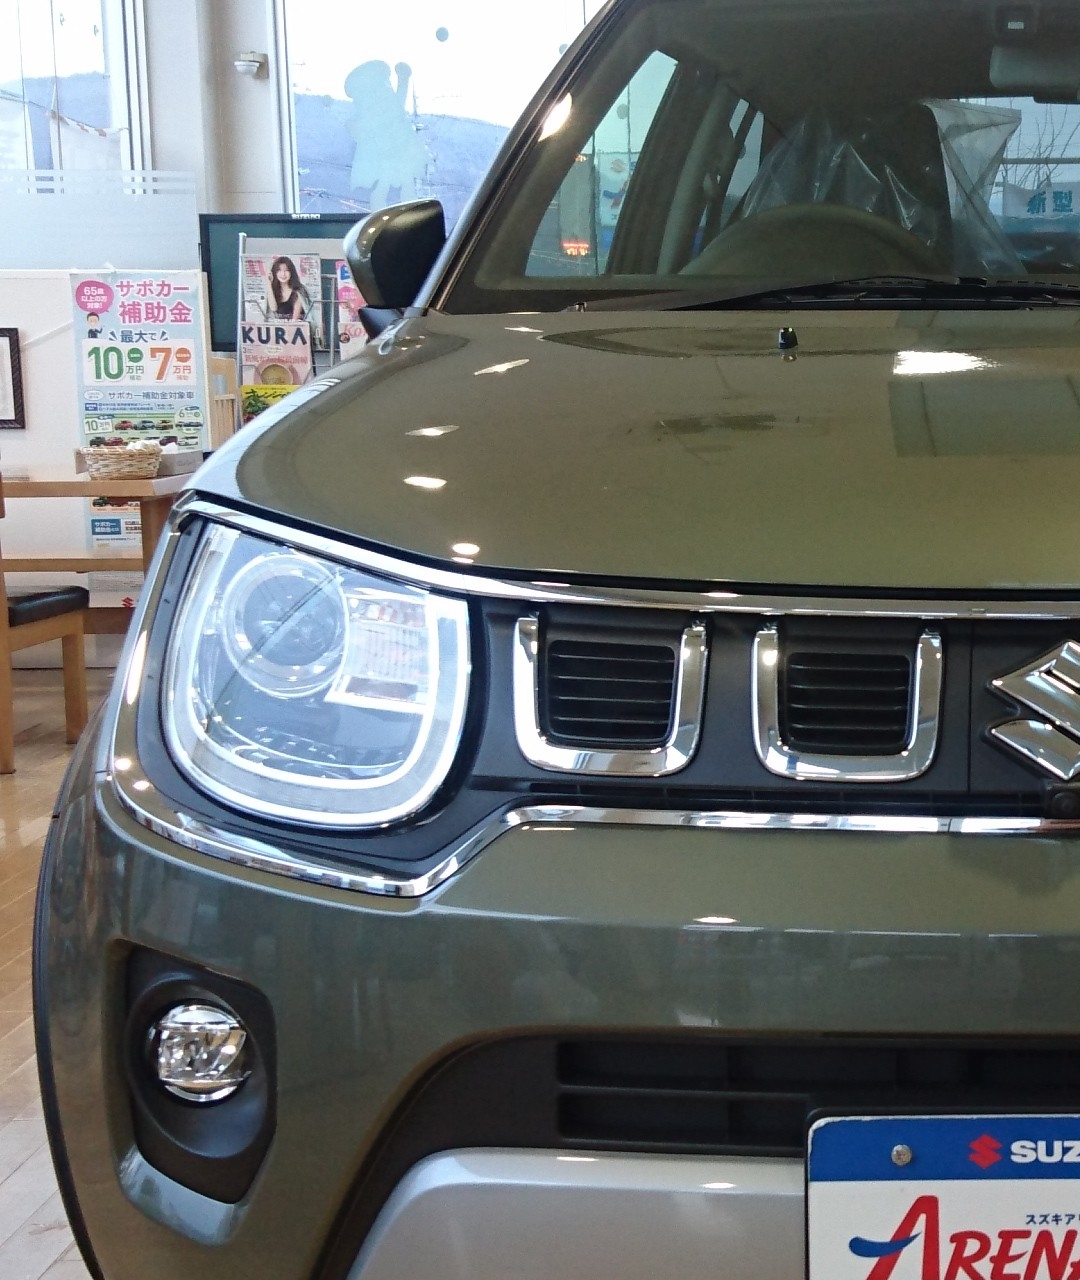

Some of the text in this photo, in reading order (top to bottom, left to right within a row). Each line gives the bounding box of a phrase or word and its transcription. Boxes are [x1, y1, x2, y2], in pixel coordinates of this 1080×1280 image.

[116, 280, 190, 297] サポカー
[119, 301, 193, 324] 補助金
[120, 330, 157, 343] 最大で
[241, 326, 308, 346] KURA
[87, 346, 124, 380] 10
[150, 347, 172, 381] 7
